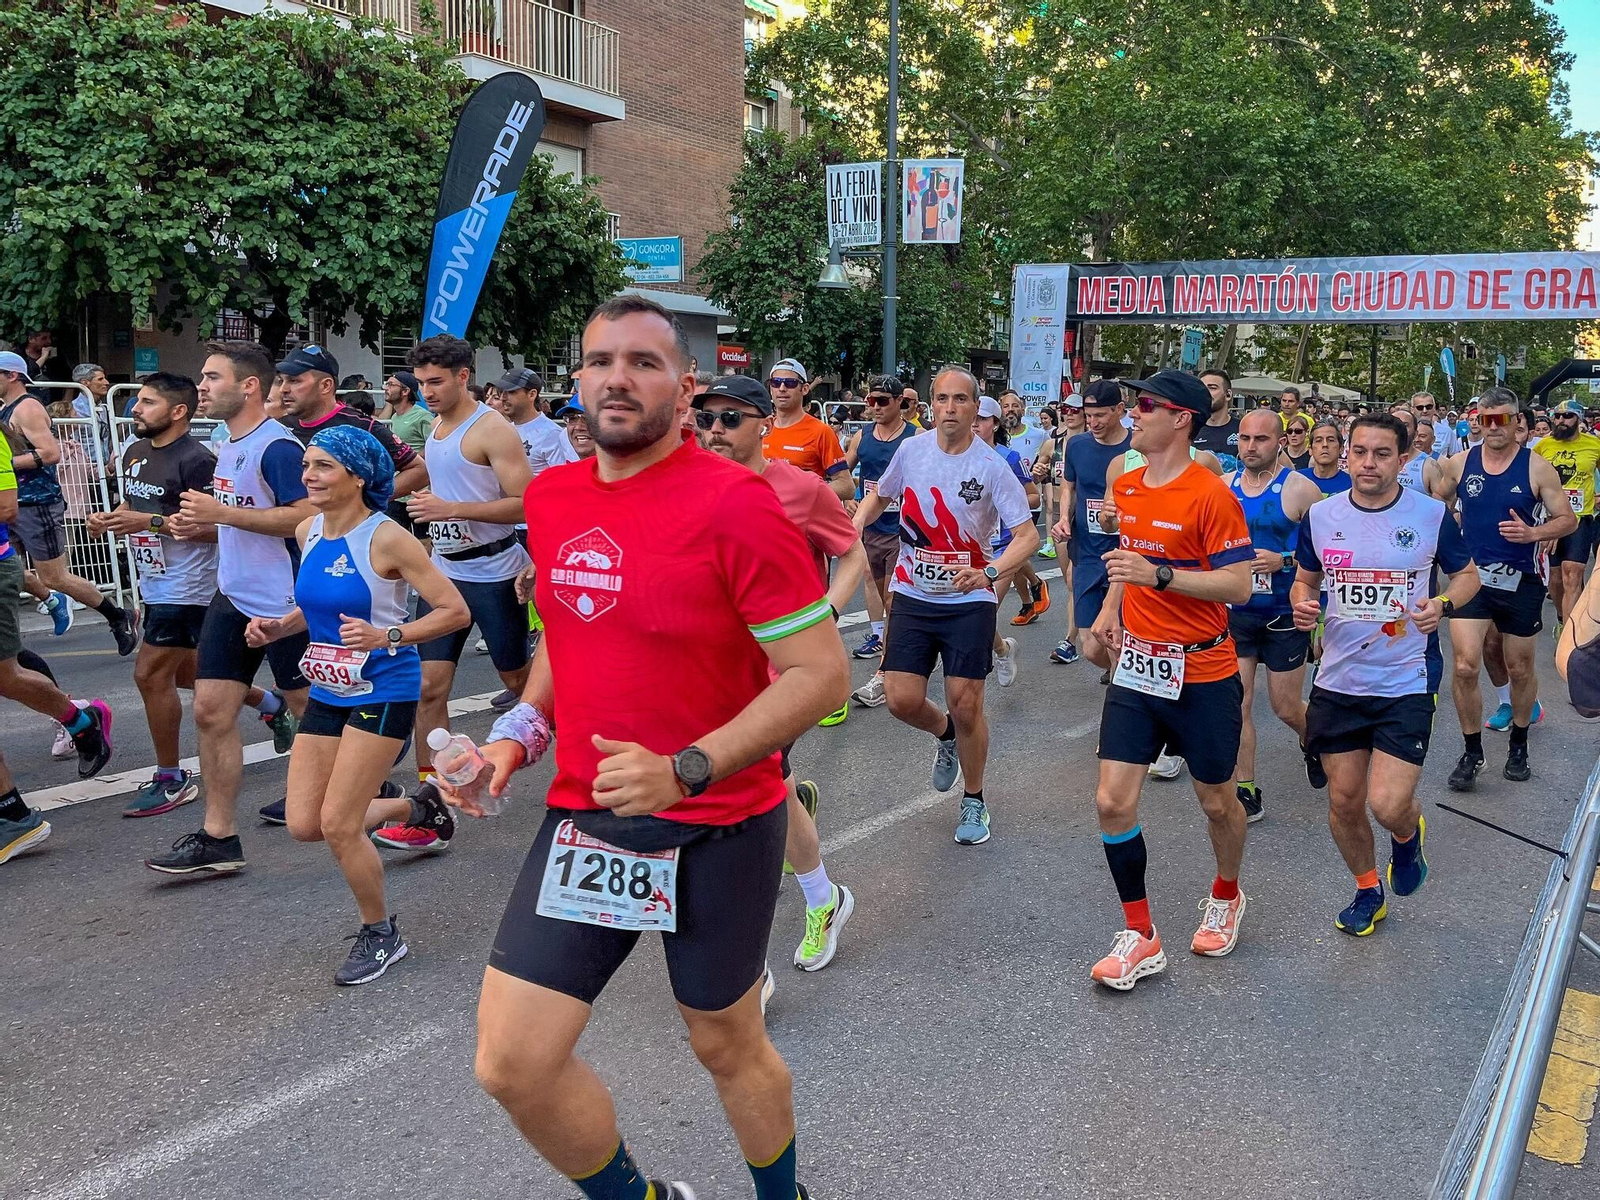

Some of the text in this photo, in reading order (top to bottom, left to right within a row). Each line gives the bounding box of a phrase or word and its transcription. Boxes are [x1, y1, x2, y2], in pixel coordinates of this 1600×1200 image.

[830, 169, 877, 198] LA FERIA
[831, 196, 877, 224] DEL VINO
[638, 243, 676, 255] GONGORA
[1077, 264, 1599, 315] MEDIA MARATÓN CIUDAD DE GRA
[1023, 381, 1048, 392] alsa
[1152, 520, 1183, 531] HORSEMAN
[1132, 539, 1165, 553] zalaris
[1337, 570, 1348, 583] 41
[1338, 584, 1394, 606] 1597
[301, 660, 351, 686] 3639
[1121, 649, 1173, 681] 3519
[554, 849, 653, 901] 1288
